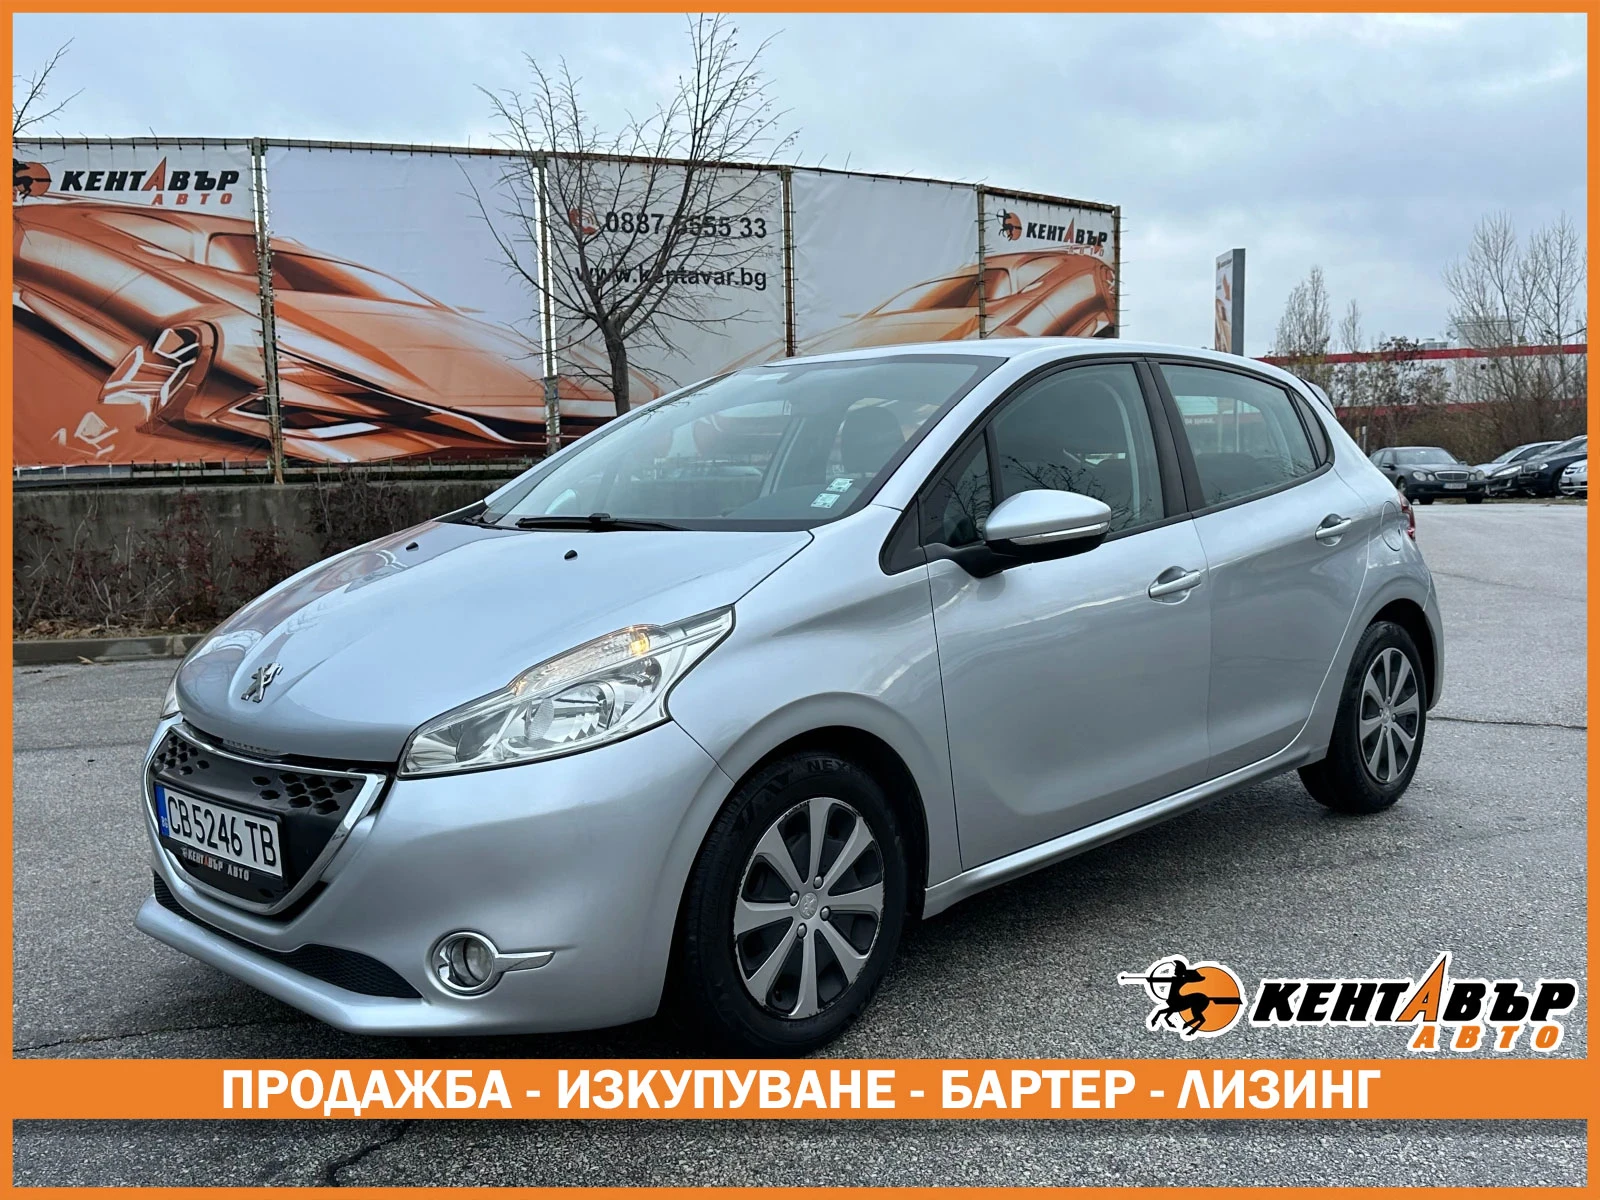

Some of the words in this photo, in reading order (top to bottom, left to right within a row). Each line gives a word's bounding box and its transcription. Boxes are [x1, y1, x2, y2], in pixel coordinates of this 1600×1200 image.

[60, 156, 239, 191] КЕНТАВЪР
[151, 193, 232, 205] АВТО
[605, 211, 664, 235] 0887
[740, 217, 767, 239] 33
[1026, 216, 1107, 246] КЕНТАВЪР
[187, 848, 224, 872] КЕНТАВЪР
[227, 863, 250, 881] АВТО
